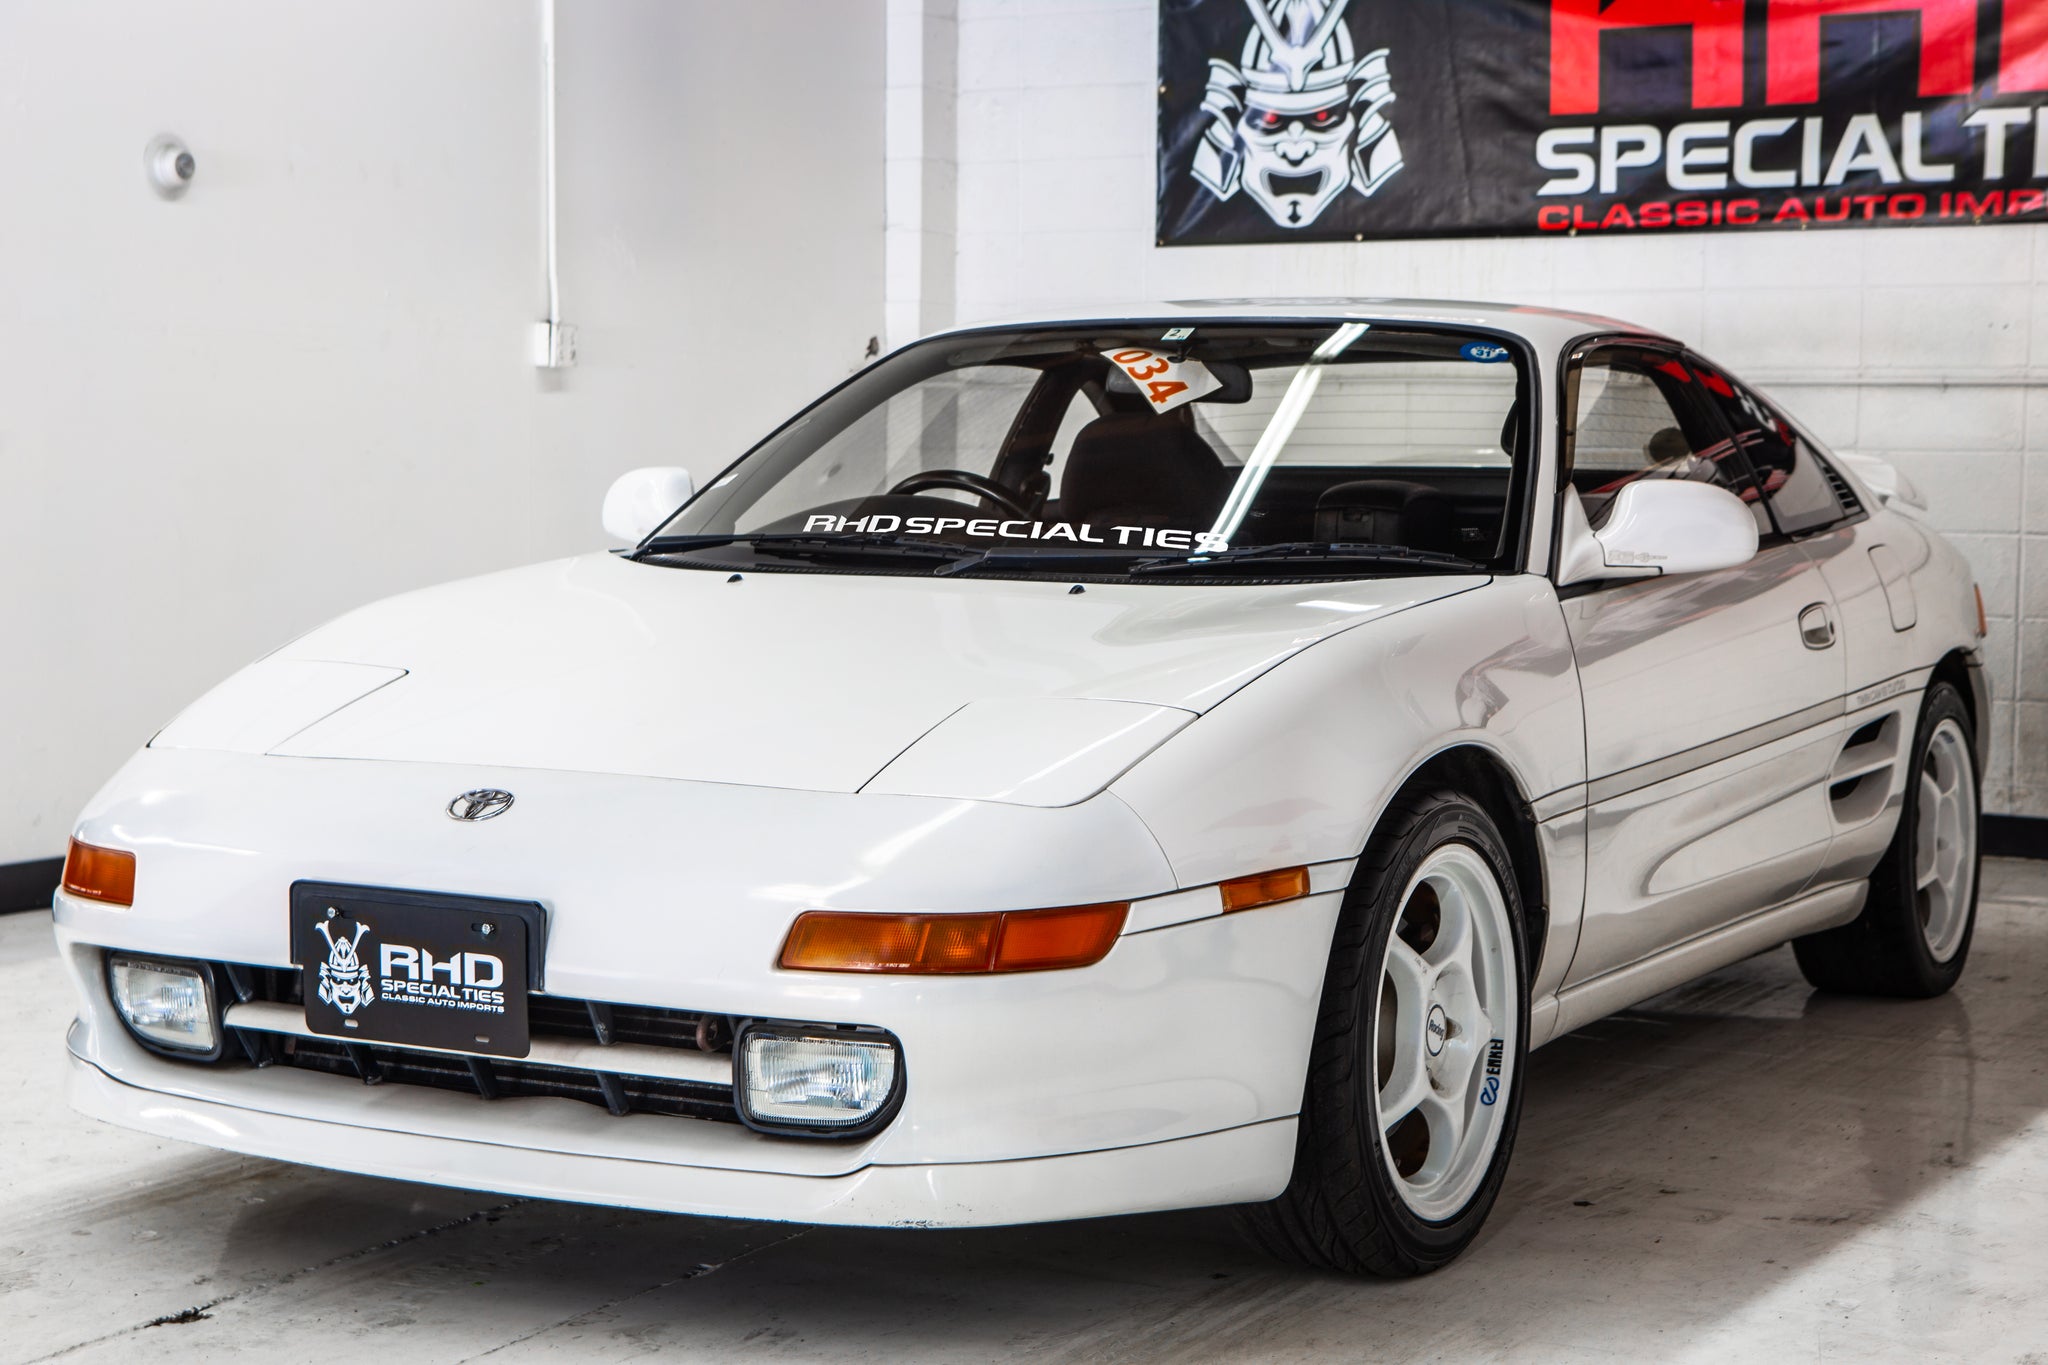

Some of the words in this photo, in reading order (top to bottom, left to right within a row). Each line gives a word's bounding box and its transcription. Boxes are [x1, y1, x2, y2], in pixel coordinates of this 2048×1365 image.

[1537, 200, 1763, 231] CLASSIC
[1772, 193, 1927, 224] AUTO
[1112, 350, 1189, 404] 034
[803, 514, 901, 533] RHD
[380, 943, 504, 987] RHD
[381, 979, 505, 1004] SPECIALTIES
[381, 992, 426, 1004] CLASSIC
[427, 998, 455, 1008] AUTO
[457, 1001, 505, 1014] IMPORTS
